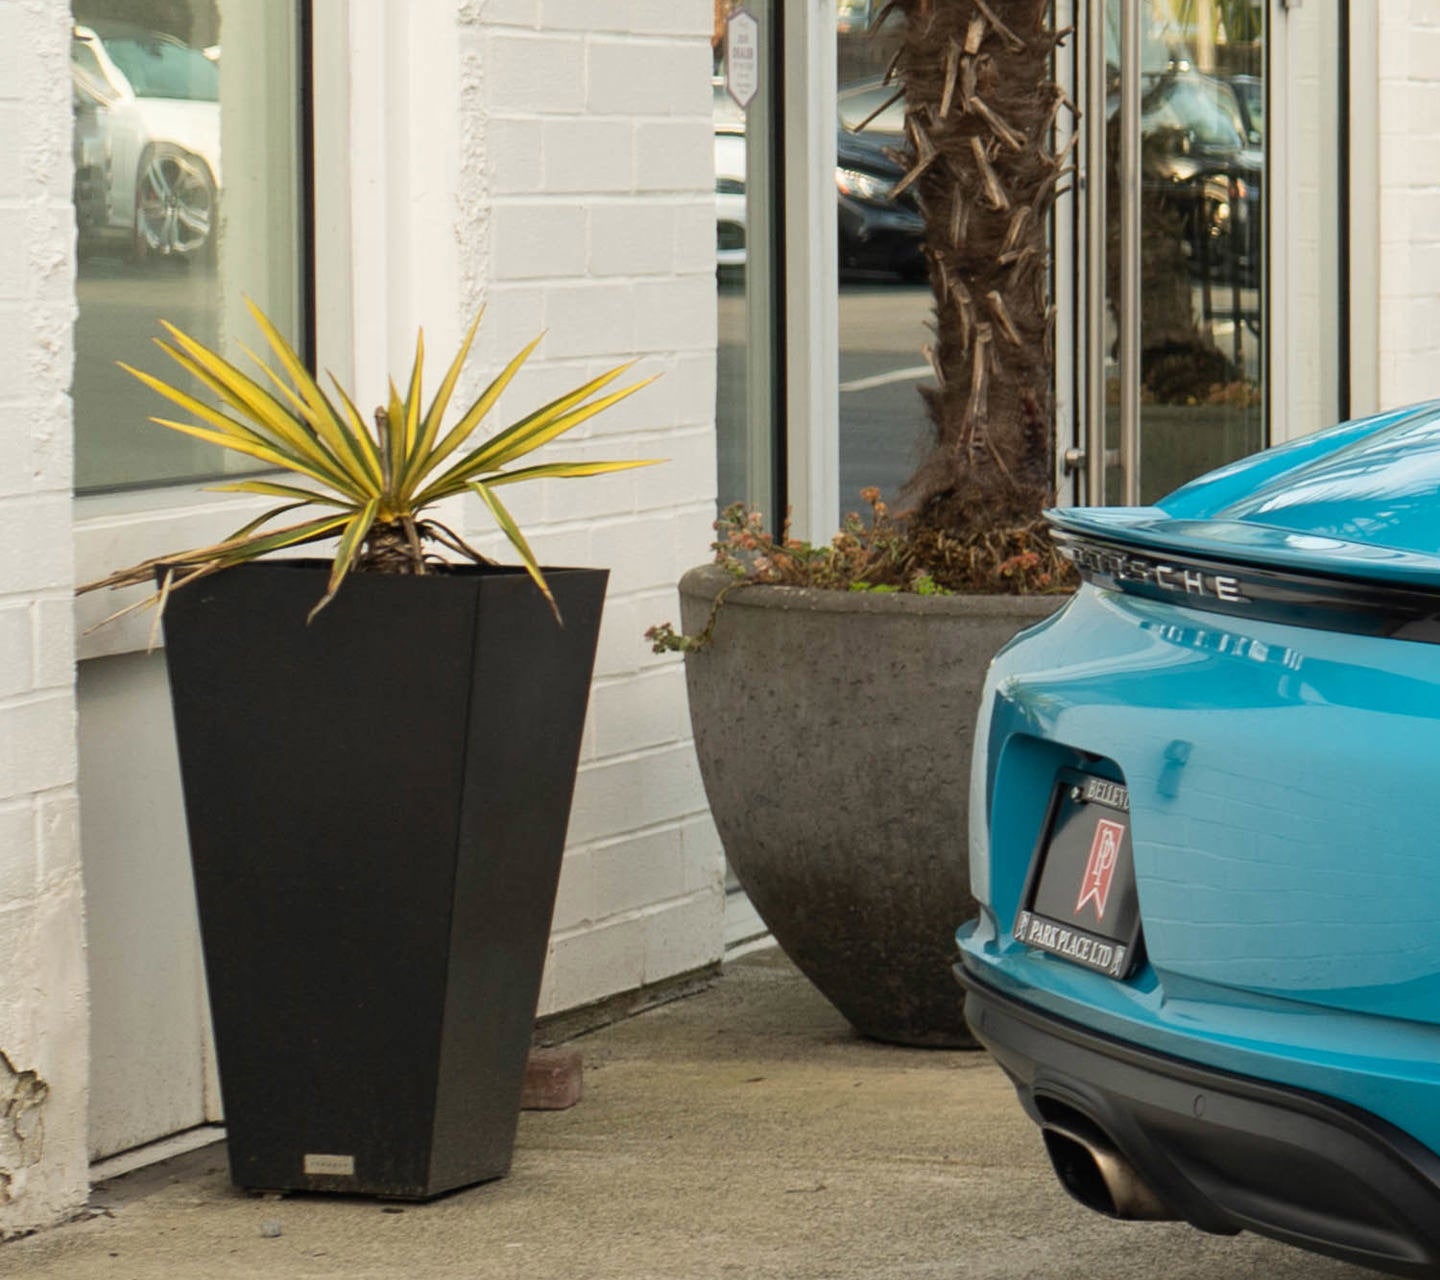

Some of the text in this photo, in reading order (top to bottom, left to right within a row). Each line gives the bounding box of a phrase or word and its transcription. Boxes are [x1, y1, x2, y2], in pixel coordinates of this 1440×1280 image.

[1028, 919, 1113, 968] PARK PLACE LTD
